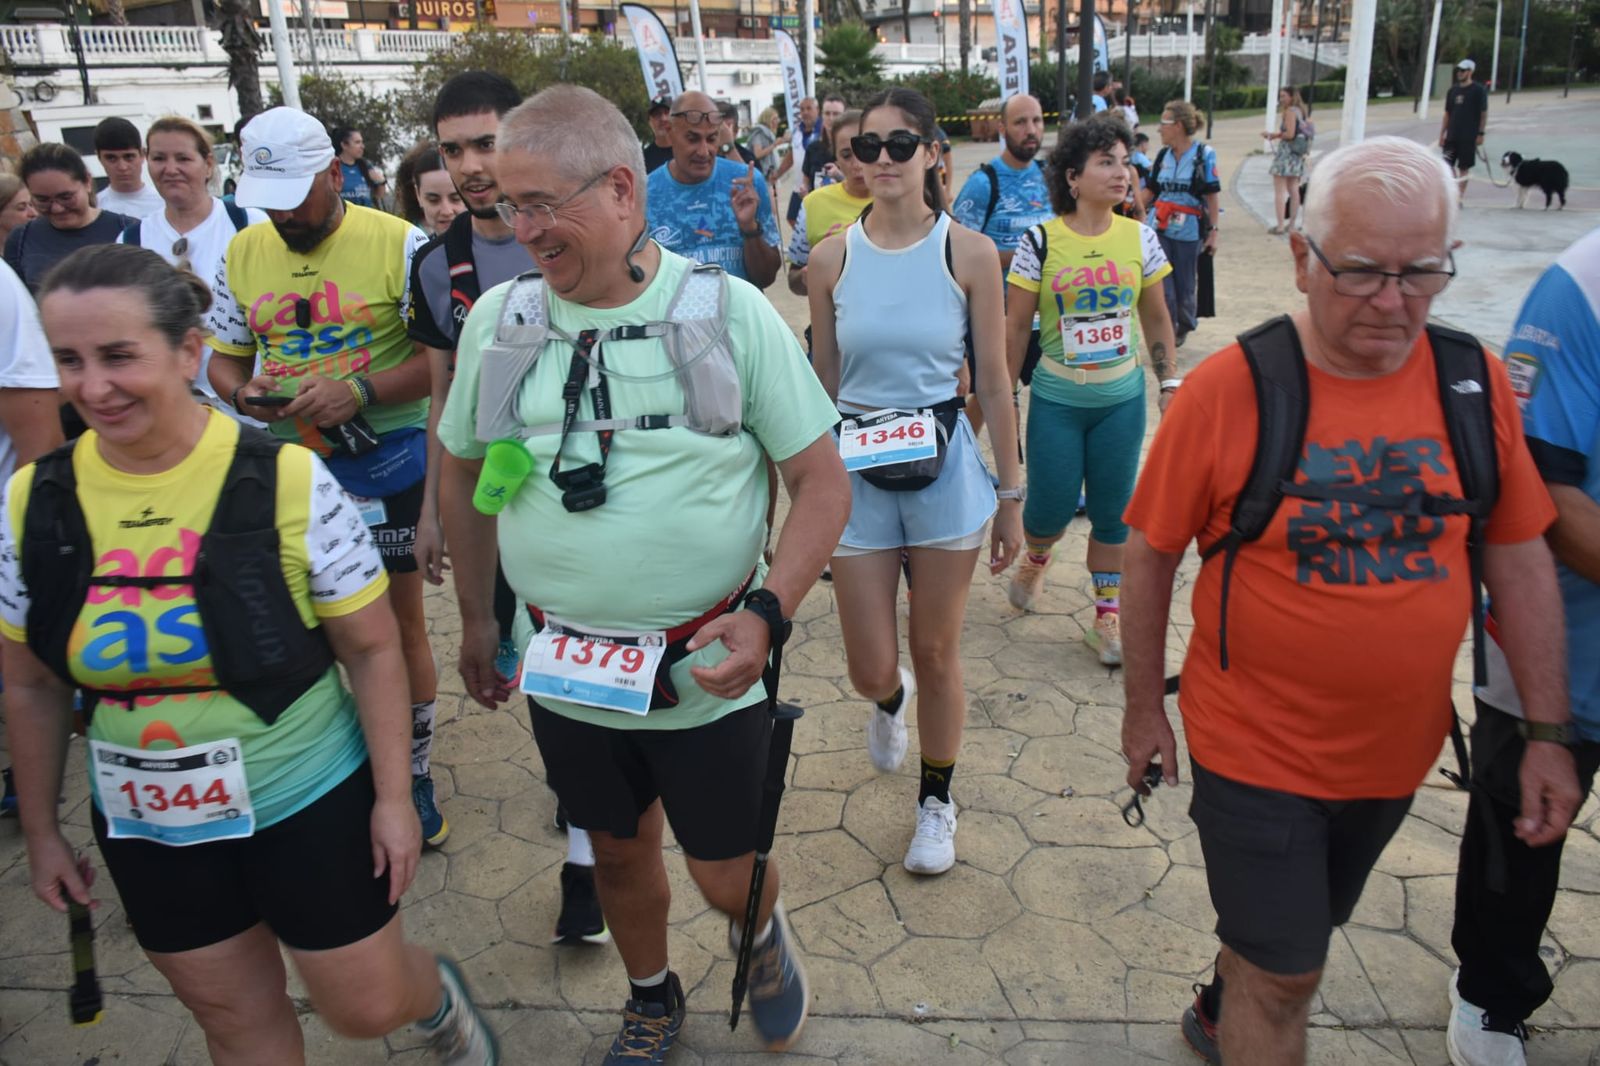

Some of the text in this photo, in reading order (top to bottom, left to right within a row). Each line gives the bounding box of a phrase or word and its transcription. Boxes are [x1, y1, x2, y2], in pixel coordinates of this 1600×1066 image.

[1074, 325, 1123, 345] 1368
[856, 422, 925, 446] 1346
[551, 634, 645, 673] 1379
[120, 778, 232, 811] 1344
